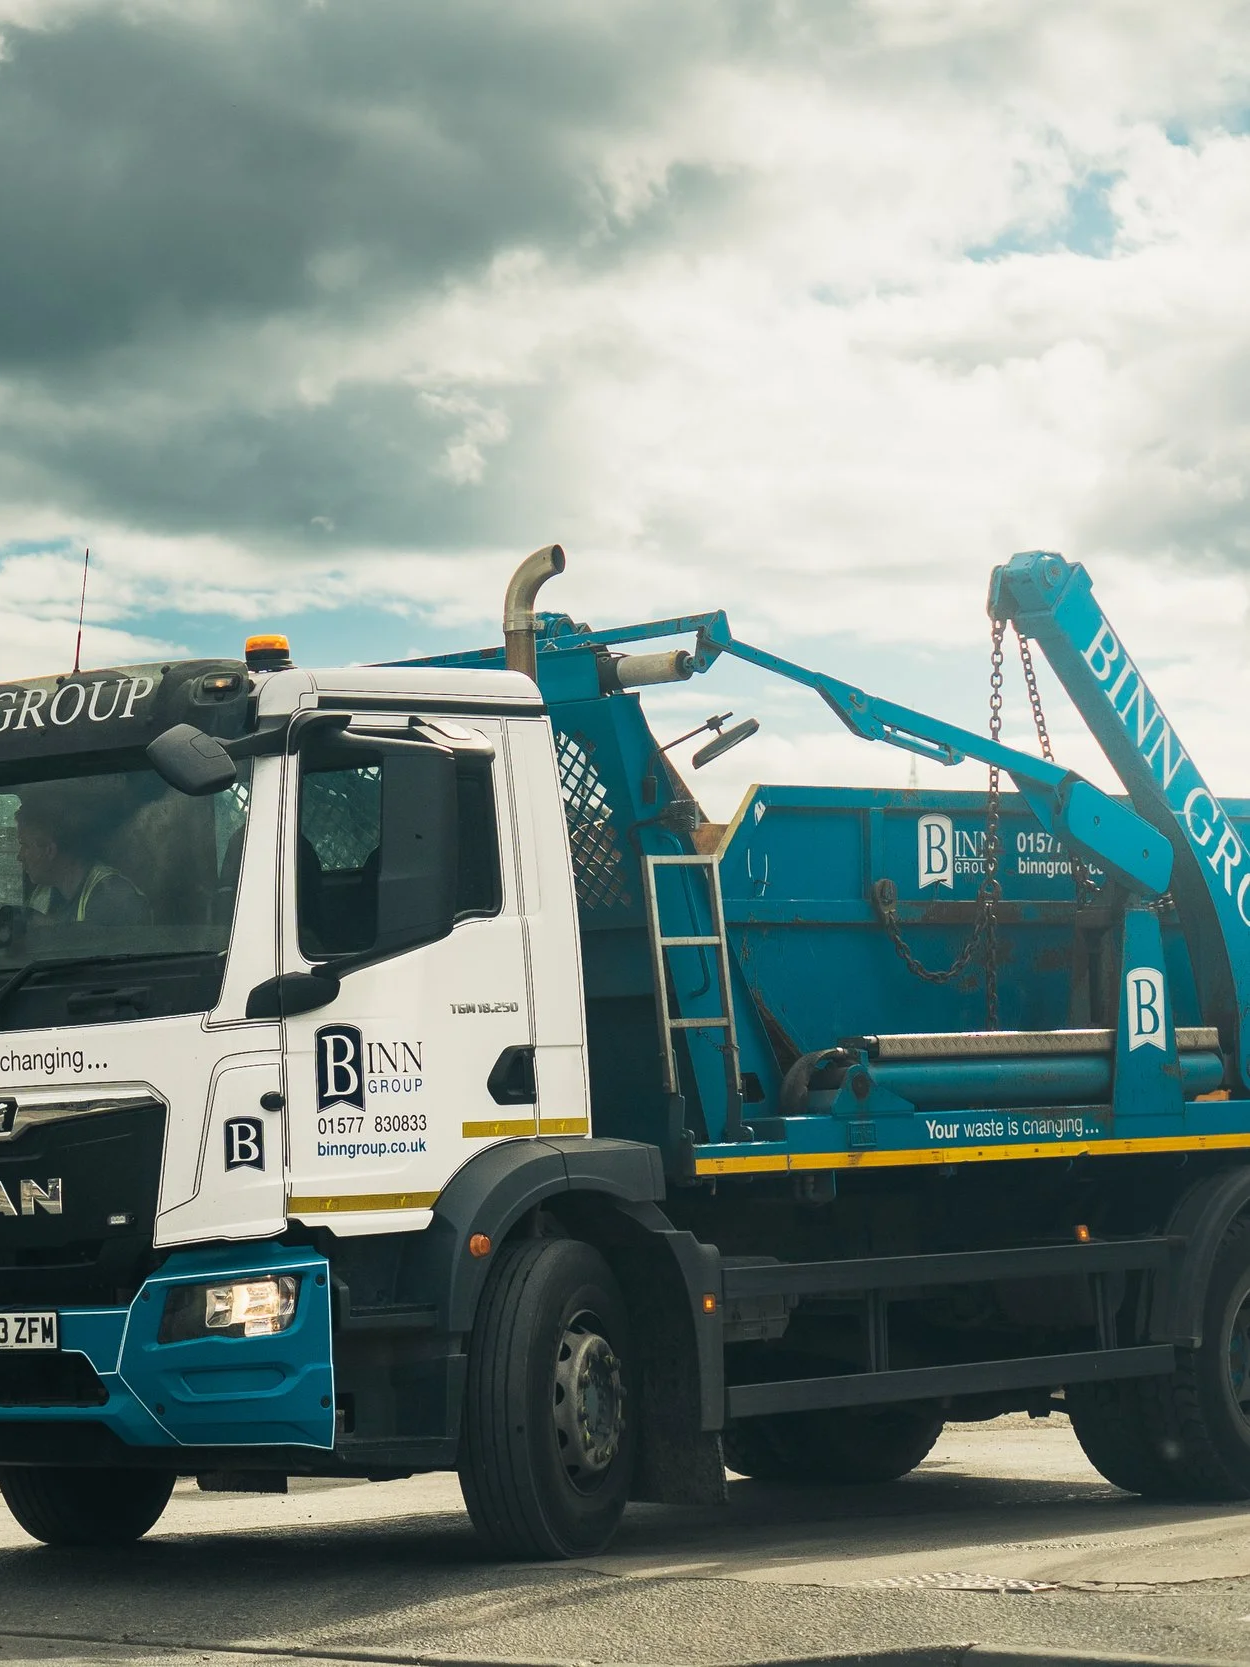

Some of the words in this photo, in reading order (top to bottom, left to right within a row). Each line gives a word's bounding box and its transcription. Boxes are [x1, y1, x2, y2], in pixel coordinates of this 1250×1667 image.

[1081, 616, 1190, 790] BINN
[1133, 979, 1160, 1035] B
[367, 1078, 423, 1094] GROUP
[317, 1117, 364, 1134] 01577
[374, 1114, 427, 1132] 830833
[925, 1119, 960, 1139] Your
[964, 1118, 1004, 1138] waste
[1007, 1117, 1019, 1136] is
[229, 1122, 259, 1164] B
[317, 1138, 427, 1159] binngroup.co.uk
[14, 1316, 54, 1343] ZFM
